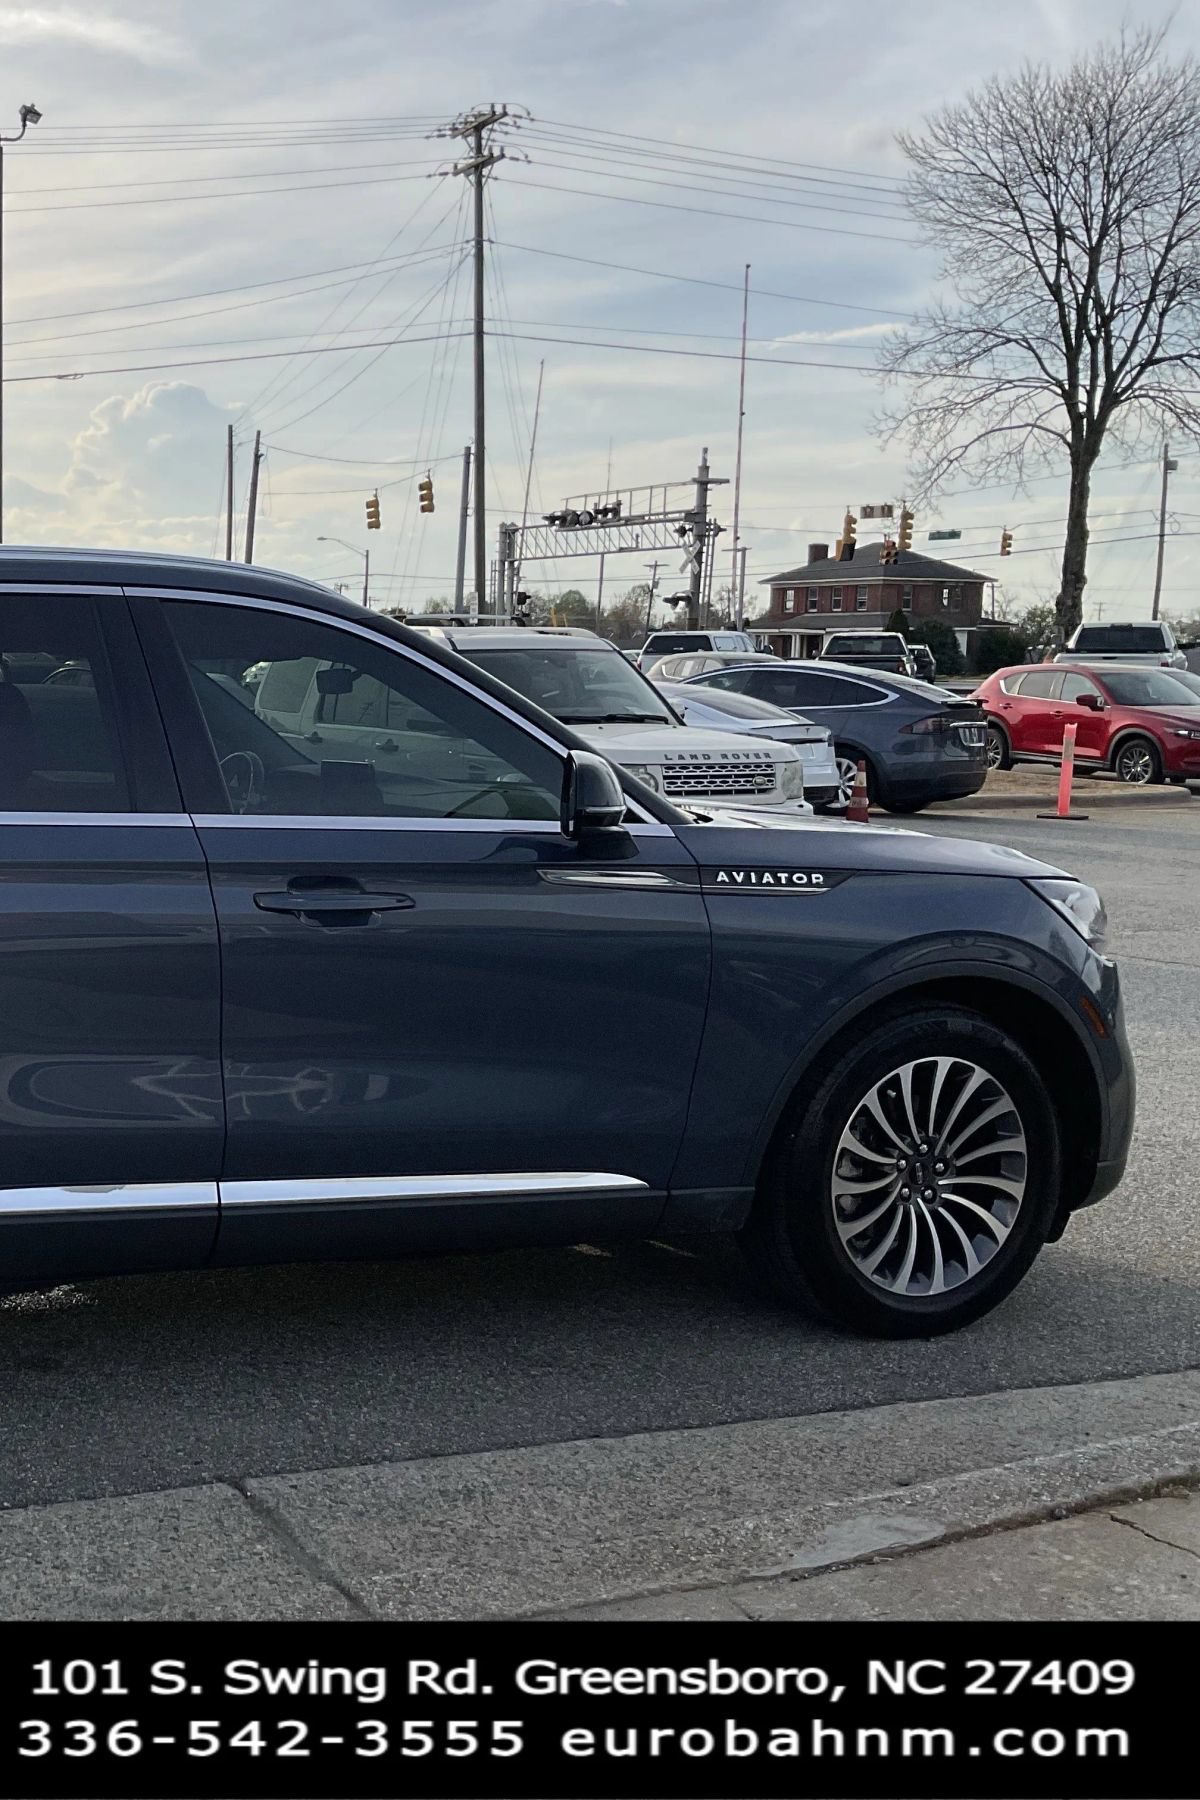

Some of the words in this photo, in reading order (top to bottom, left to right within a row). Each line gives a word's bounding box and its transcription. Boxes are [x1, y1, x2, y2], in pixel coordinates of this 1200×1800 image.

[664, 753, 712, 761] LAND
[720, 752, 773, 761] ROVER
[716, 871, 825, 885] AVIATOR
